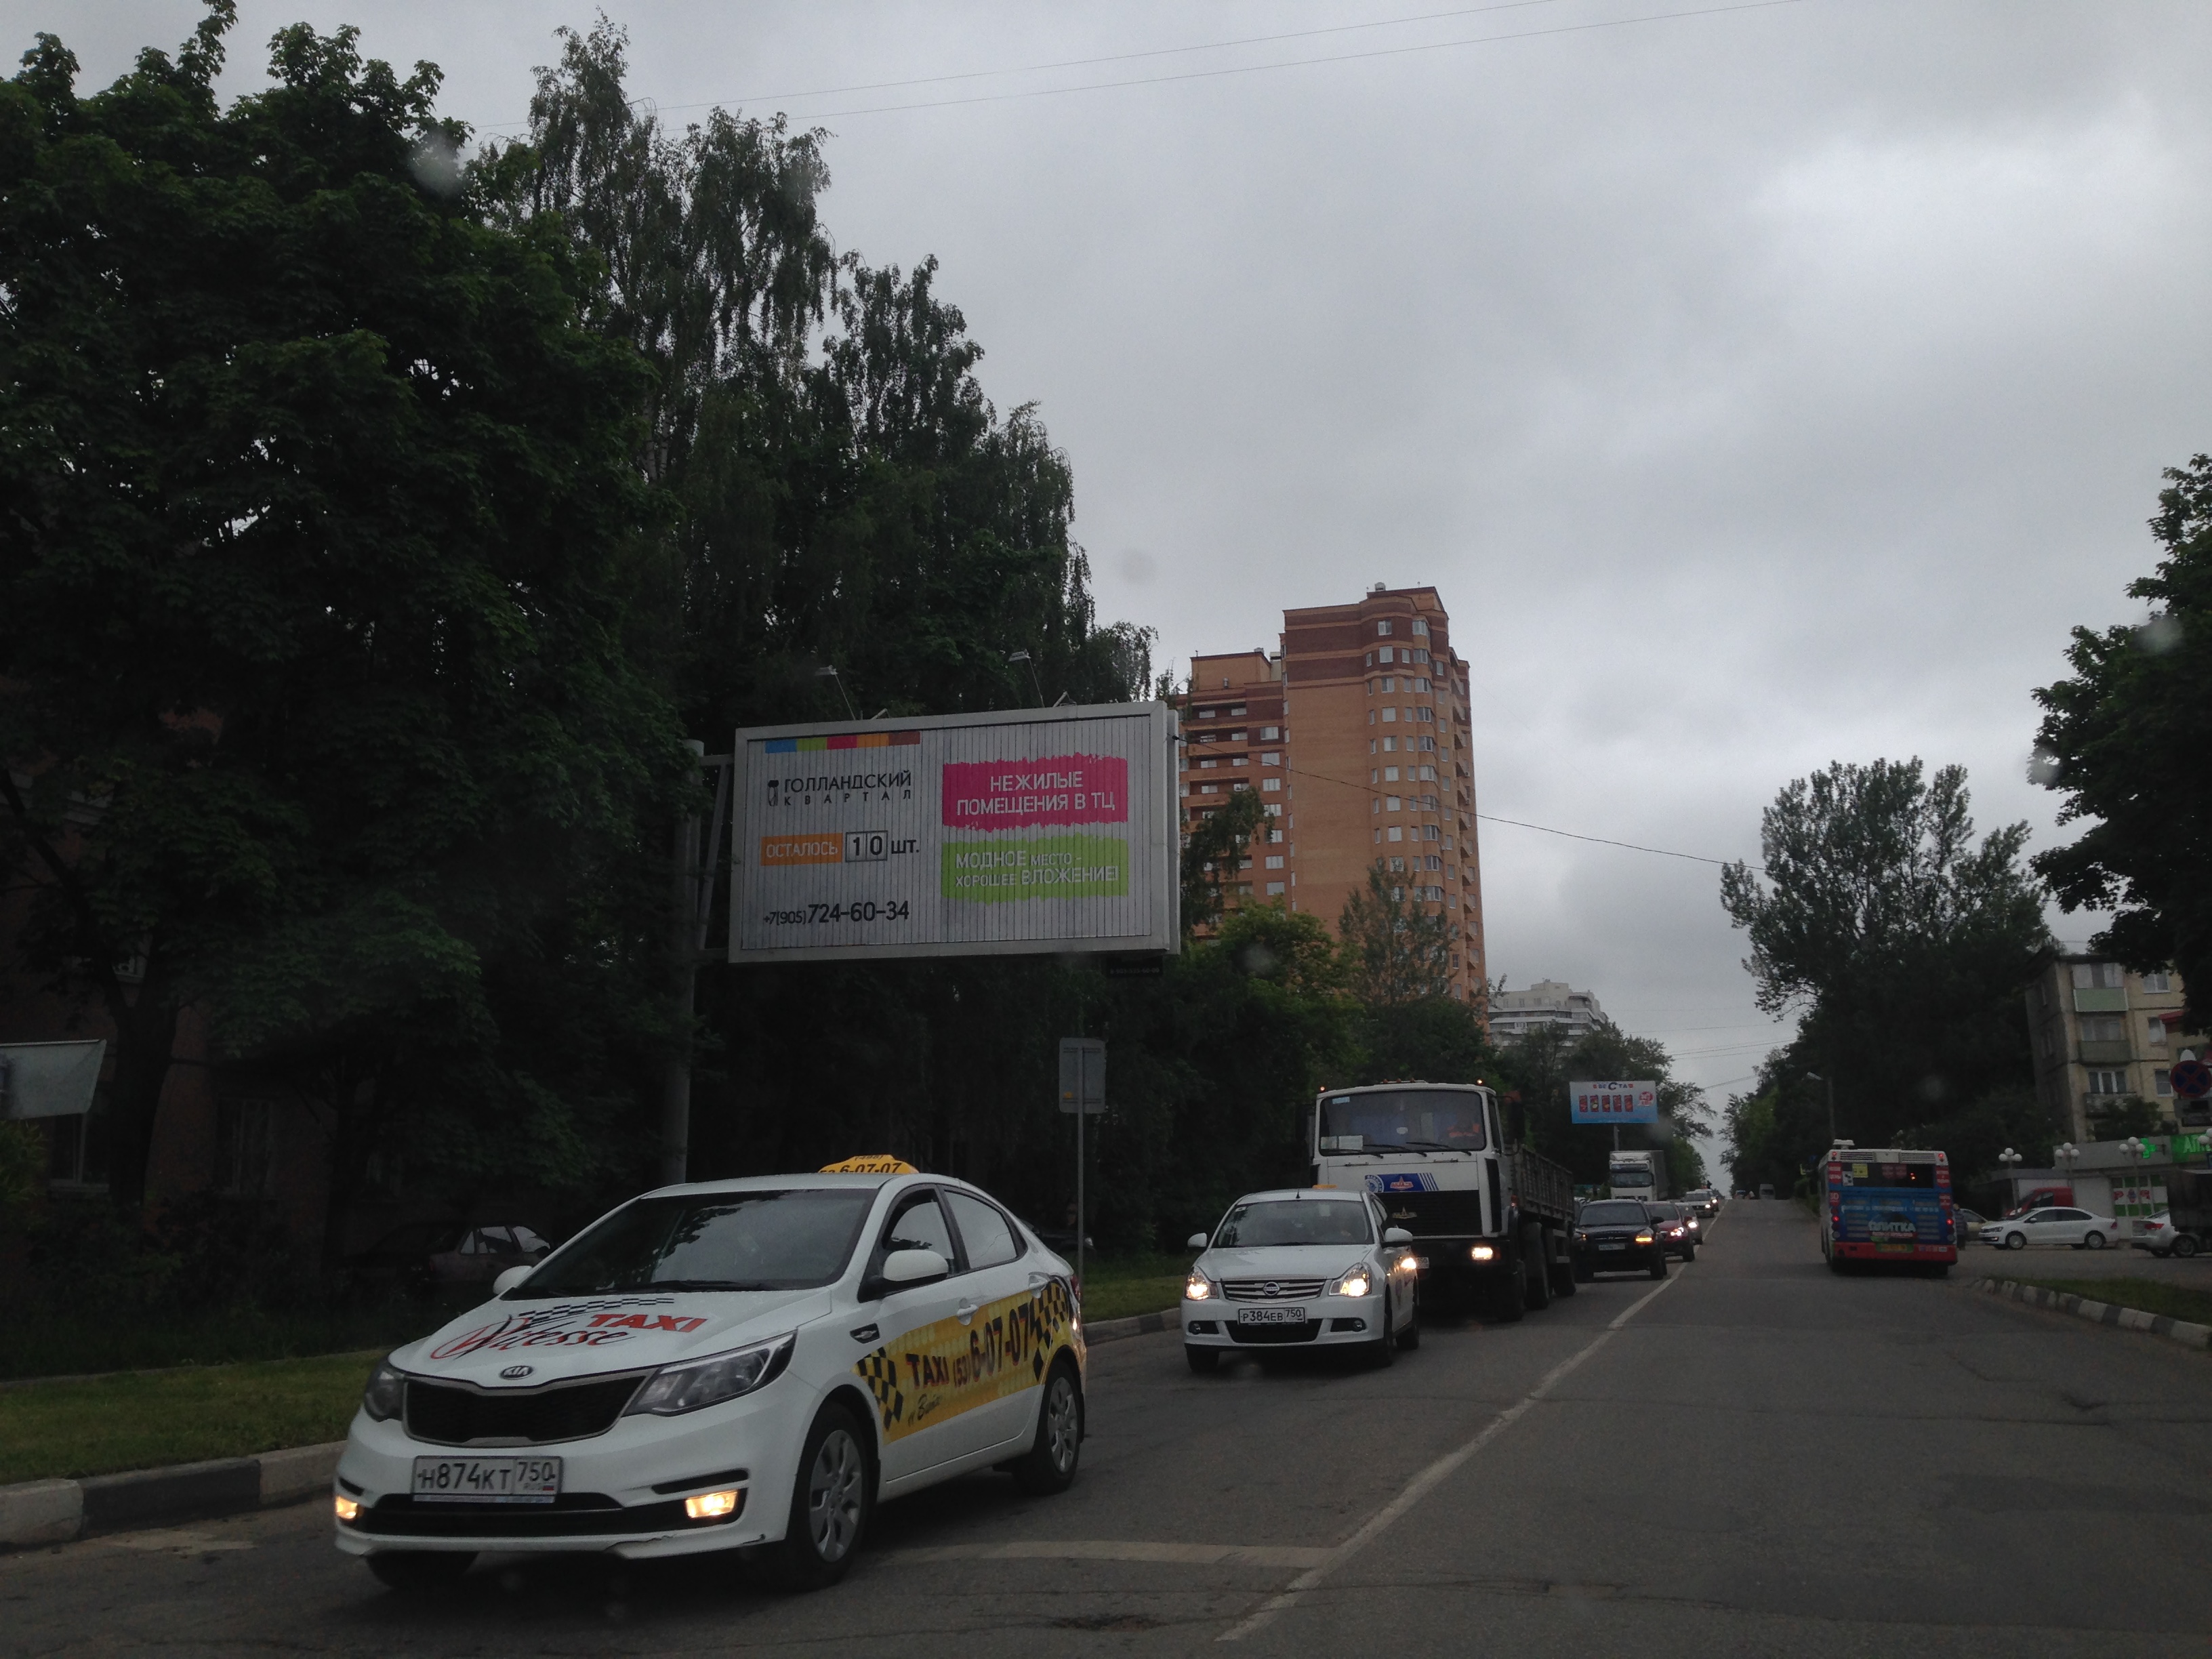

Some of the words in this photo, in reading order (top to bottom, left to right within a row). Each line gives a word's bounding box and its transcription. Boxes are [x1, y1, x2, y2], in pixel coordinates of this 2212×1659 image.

[783, 770, 912, 793] ГОЛЛАНДСКИЙ
[989, 771, 1084, 792] НЕЖИЛЫЕ
[783, 789, 912, 806] КВАРТАЛ
[957, 794, 1069, 816] ПОМЕЩЕНИЯ
[1074, 793, 1086, 810] В
[1090, 792, 1115, 811] ТЦ
[766, 841, 838, 858] ОСТАЛОСЬ
[853, 836, 884, 857] 10
[956, 851, 1027, 870] МОДНОЕ
[1030, 853, 1072, 867] МЕСТО
[956, 873, 1017, 888] ХОРОШЕЕ
[1020, 865, 1118, 886] ВЛОЖЕНИЕ!
[587, 1313, 708, 1333] TAXI
[1285, 1309, 1301, 1318] 750
[504, 1366, 531, 1376] KIA
[905, 1353, 949, 1389] TAXI
[518, 1461, 552, 1482] 750
